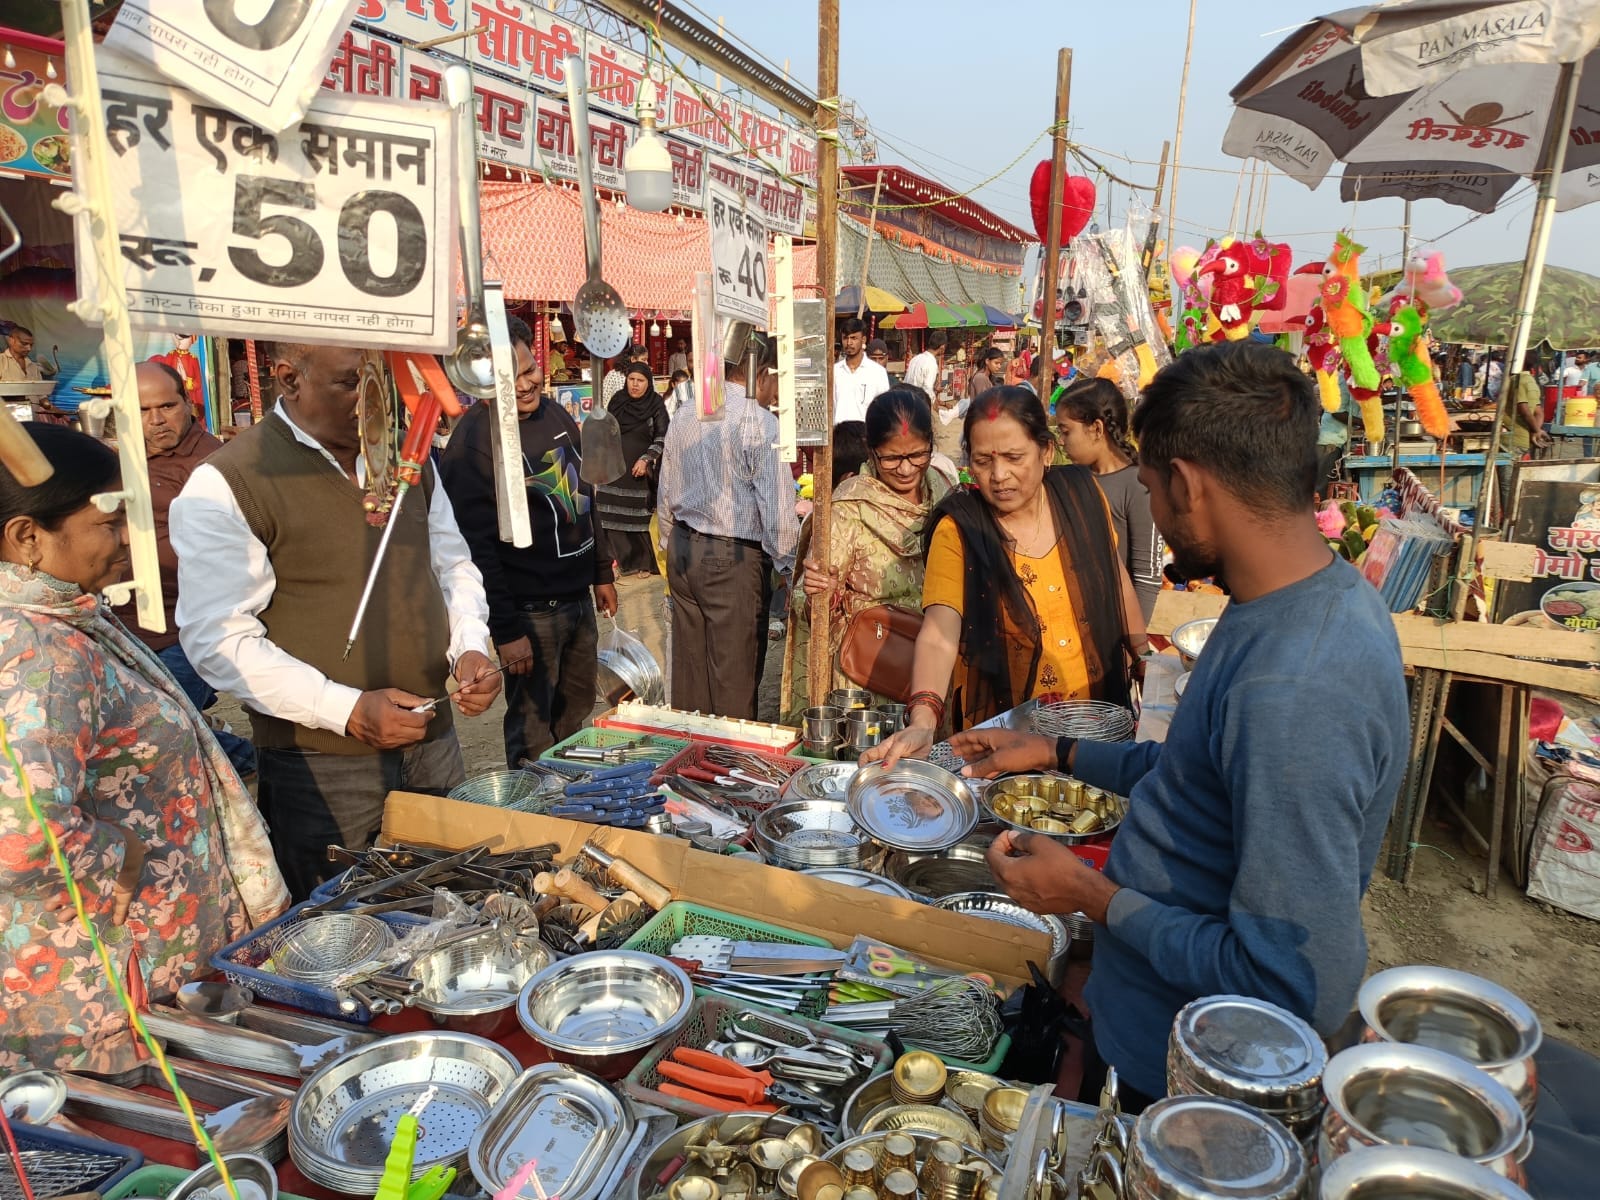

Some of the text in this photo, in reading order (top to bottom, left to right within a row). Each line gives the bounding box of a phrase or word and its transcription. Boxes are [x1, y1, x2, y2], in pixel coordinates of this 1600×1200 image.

[119, 8, 144, 26] मान
[148, 23, 188, 51] वापस
[224, 66, 256, 89] होगा
[1418, 12, 1545, 59] PAN MASALA
[101, 88, 173, 157] हर
[191, 103, 280, 175] एक
[300, 122, 431, 187] समान
[227, 173, 428, 299] 50
[712, 196, 726, 230] हर
[727, 204, 745, 240] एक
[738, 244, 767, 302] 40
[231, 303, 261, 319] हुआ
[268, 307, 307, 322] समान
[313, 310, 350, 325] वापस
[386, 314, 415, 330] होगा
